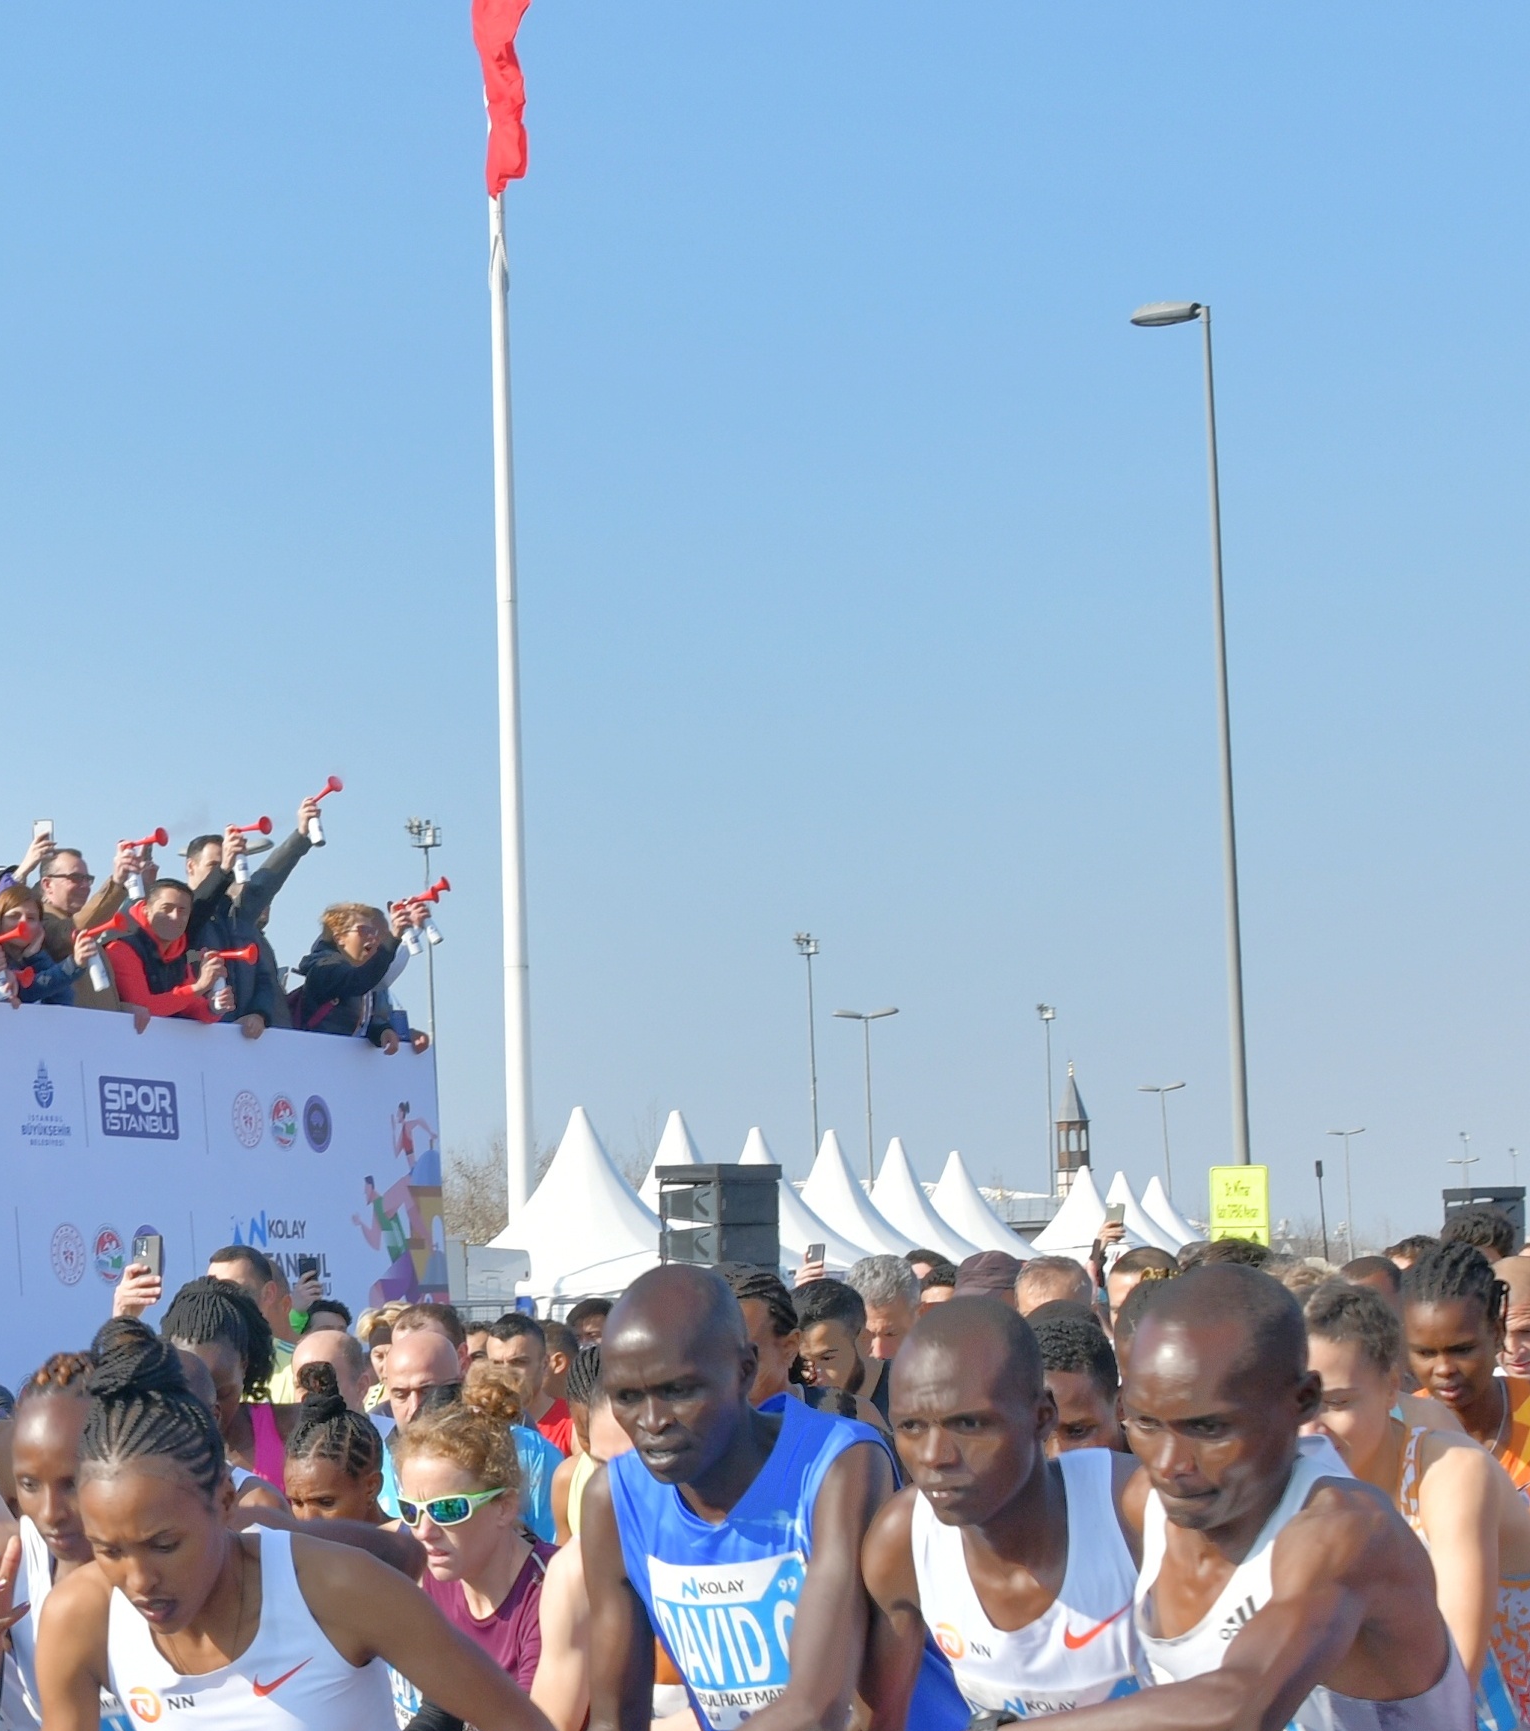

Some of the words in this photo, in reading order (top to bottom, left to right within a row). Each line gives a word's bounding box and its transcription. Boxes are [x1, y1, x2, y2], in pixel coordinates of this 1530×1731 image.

[103, 1081, 174, 1114] SPOR
[268, 1218, 307, 1240] KOLAY
[699, 1578, 745, 1595] KOLAY
[778, 1575, 798, 1593] 99
[656, 1596, 772, 1686] DAVID
[719, 1691, 753, 1708] HALF
